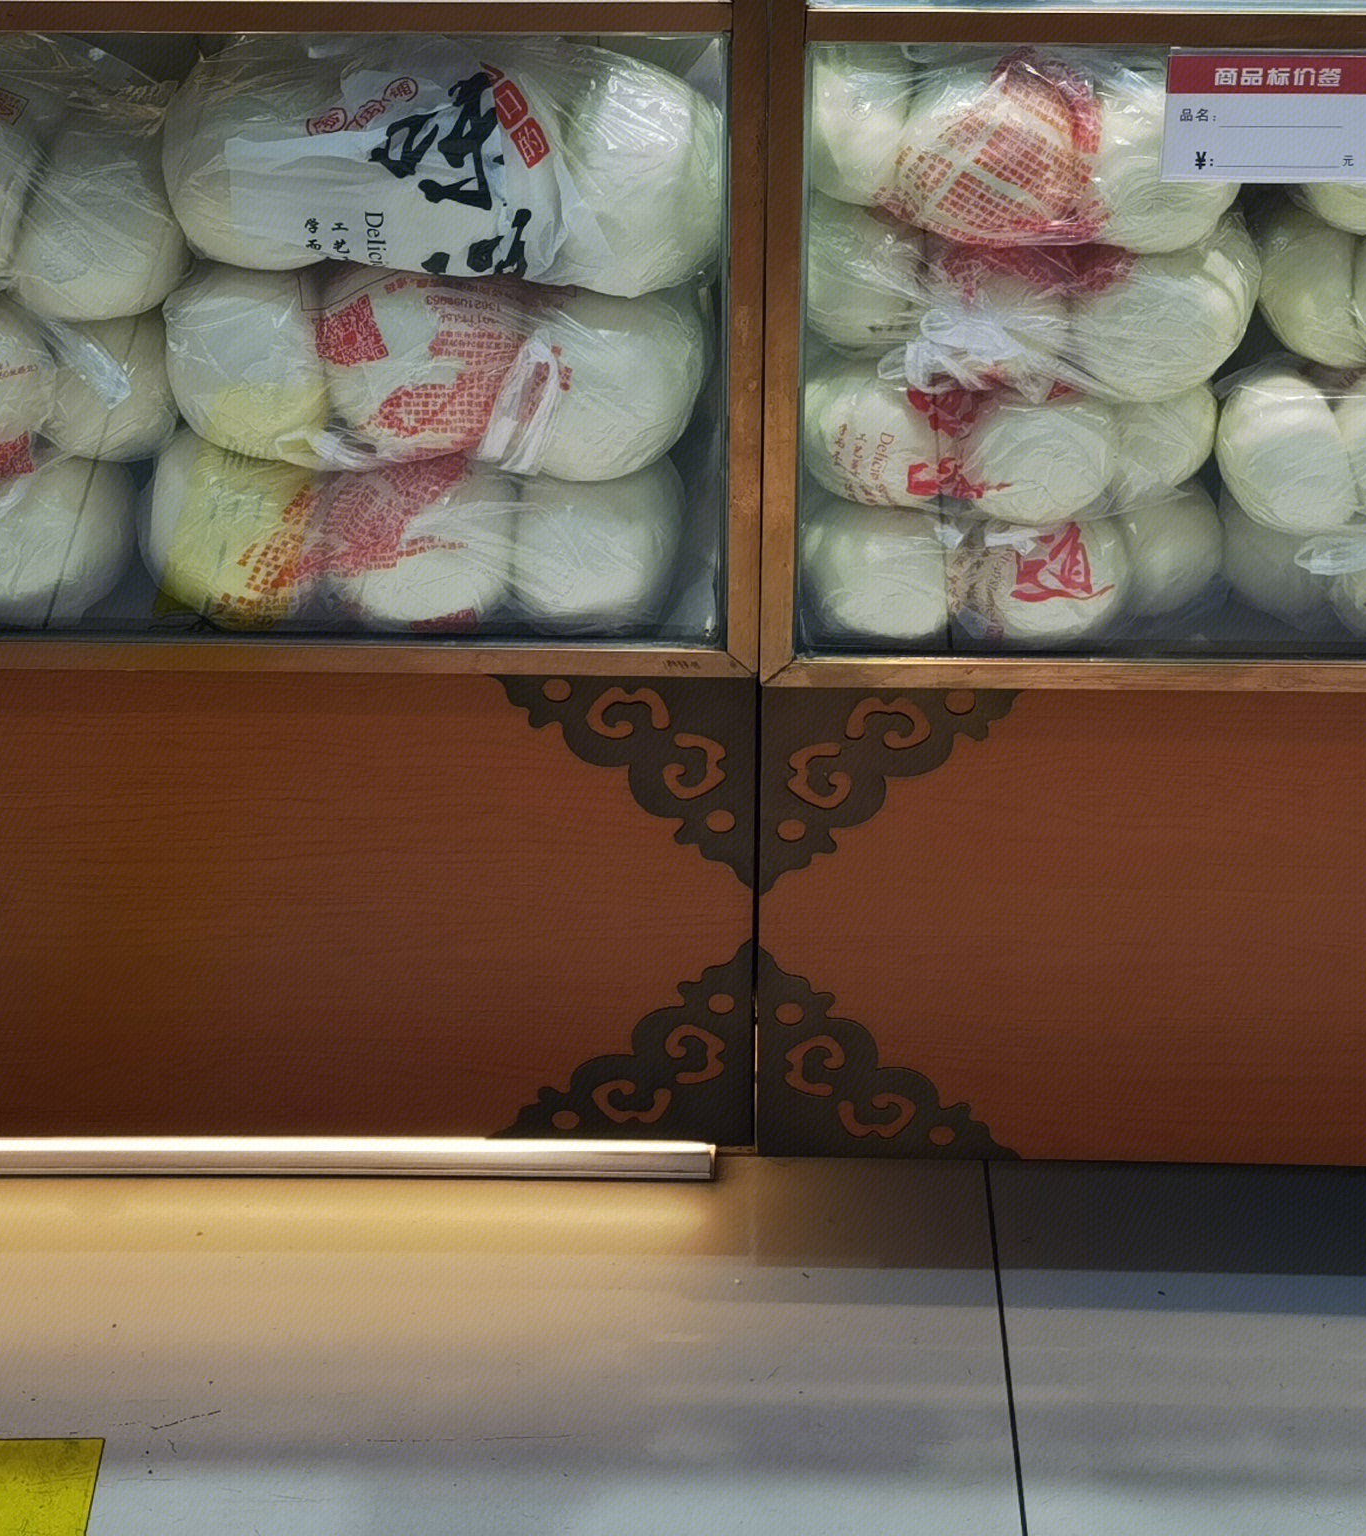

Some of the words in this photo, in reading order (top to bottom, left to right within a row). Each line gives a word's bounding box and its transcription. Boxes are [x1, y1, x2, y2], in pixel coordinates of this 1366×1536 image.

[1214, 67, 1342, 88] 商品标价签
[1342, 154, 1354, 167] 元
